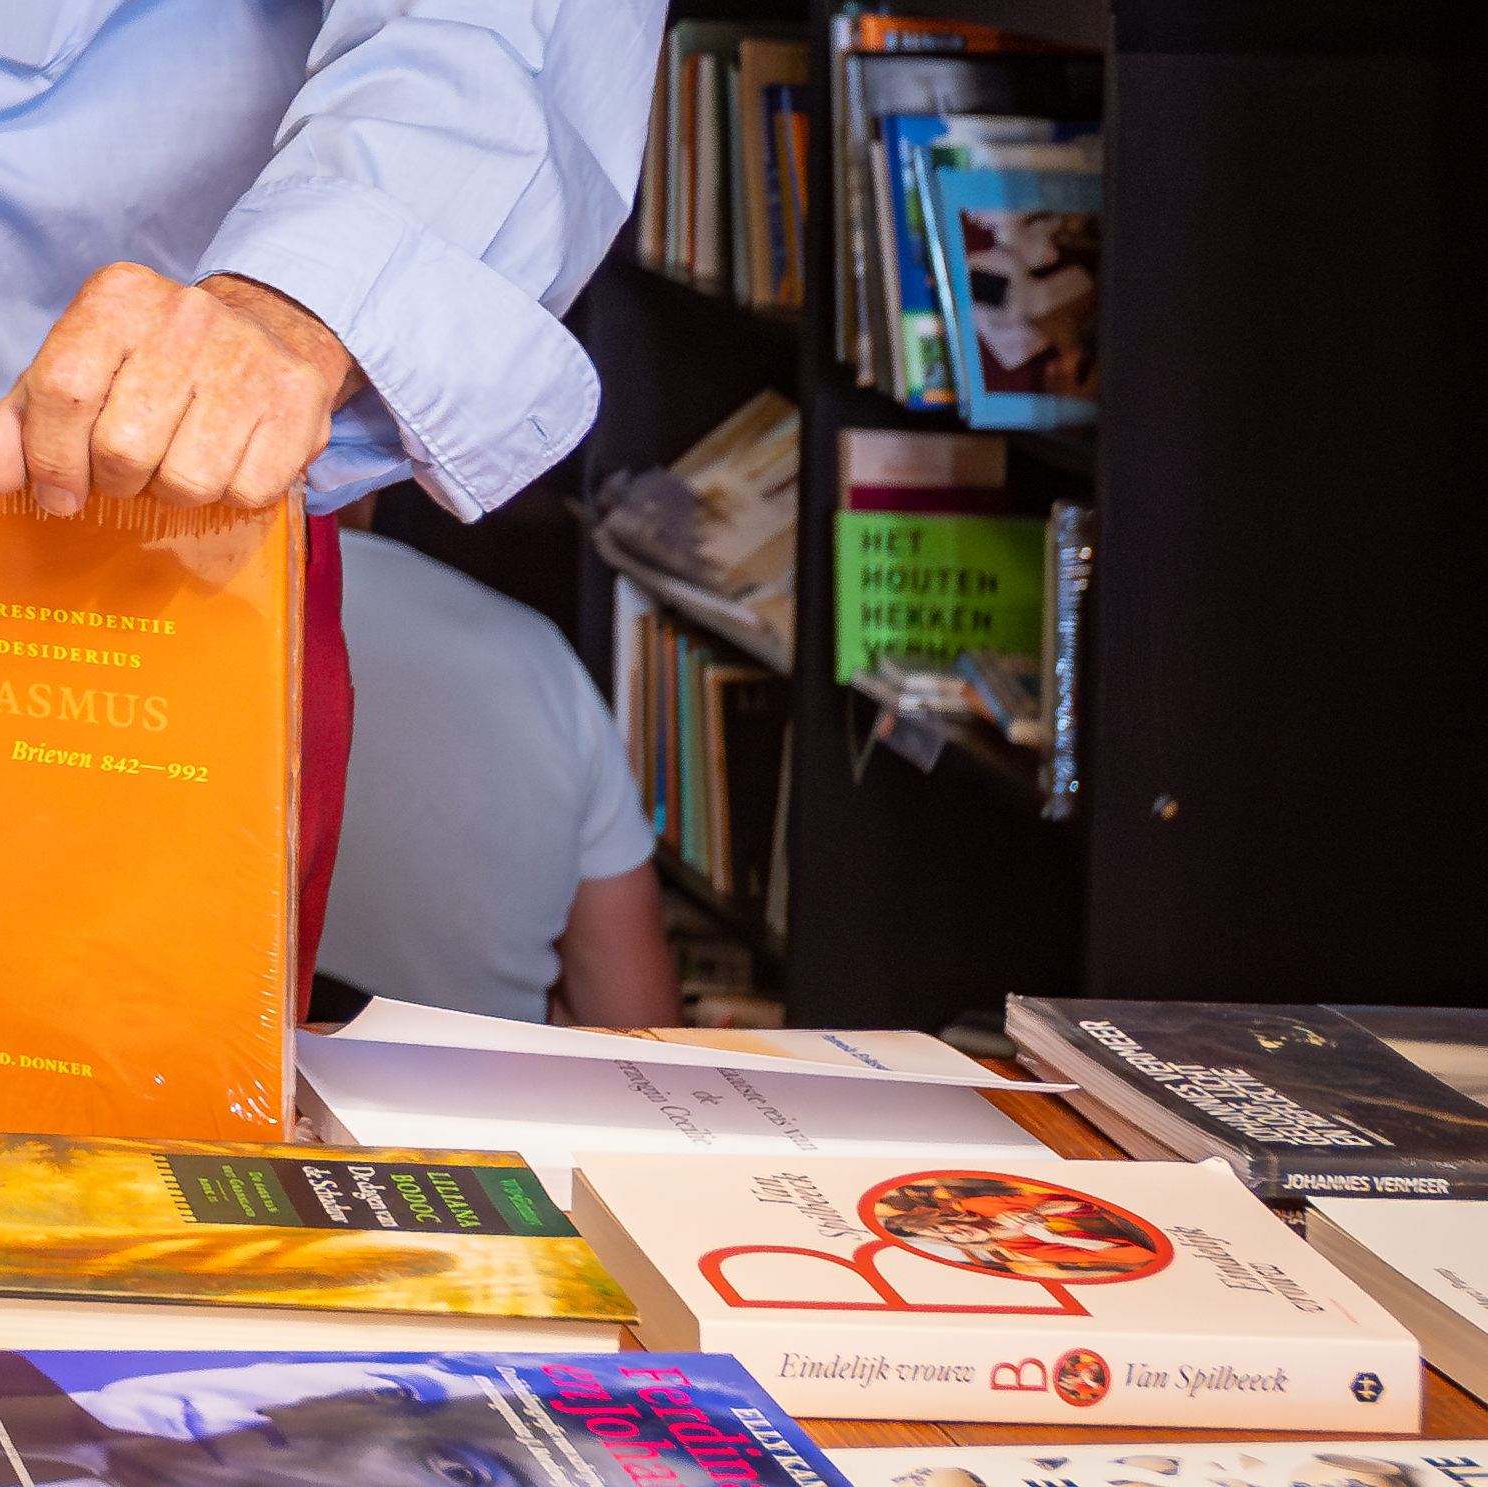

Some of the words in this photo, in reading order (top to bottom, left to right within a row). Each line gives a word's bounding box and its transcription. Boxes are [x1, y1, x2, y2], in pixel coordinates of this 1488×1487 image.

[861, 563, 999, 597] HOUTEN
[11, 740, 93, 771] Brieven
[19, 1053, 93, 1078] DONKER
[1078, 1019, 1185, 1083] VERMEER
[691, 1090, 724, 1105] de
[1166, 1061, 1247, 1104] LICHT
[756, 1104, 799, 1128] reis
[1163, 1083, 1289, 1143] JOHANNES
[301, 1165, 332, 1179] de
[346, 1165, 376, 1181] De
[1282, 1172, 1371, 1192] JOHANNES
[1372, 1175, 1453, 1195] VERMEER
[307, 1178, 353, 1224] Schaduw
[351, 1181, 387, 1210] dagen
[390, 1173, 443, 1224] BODOC
[426, 1170, 482, 1228] LILIANA
[375, 1210, 400, 1227] van
[1163, 1225, 1275, 1295] Eindelijk
[540, 1363, 613, 1401] en
[777, 1351, 891, 1388] Eindelijk
[894, 1363, 976, 1386] vrouw
[1124, 1361, 1170, 1390] Van
[1174, 1363, 1289, 1399] Spilbeeck
[549, 1399, 687, 1487] Joha
[618, 1365, 765, 1487] Ferdin
[729, 1406, 799, 1458] ELLY
